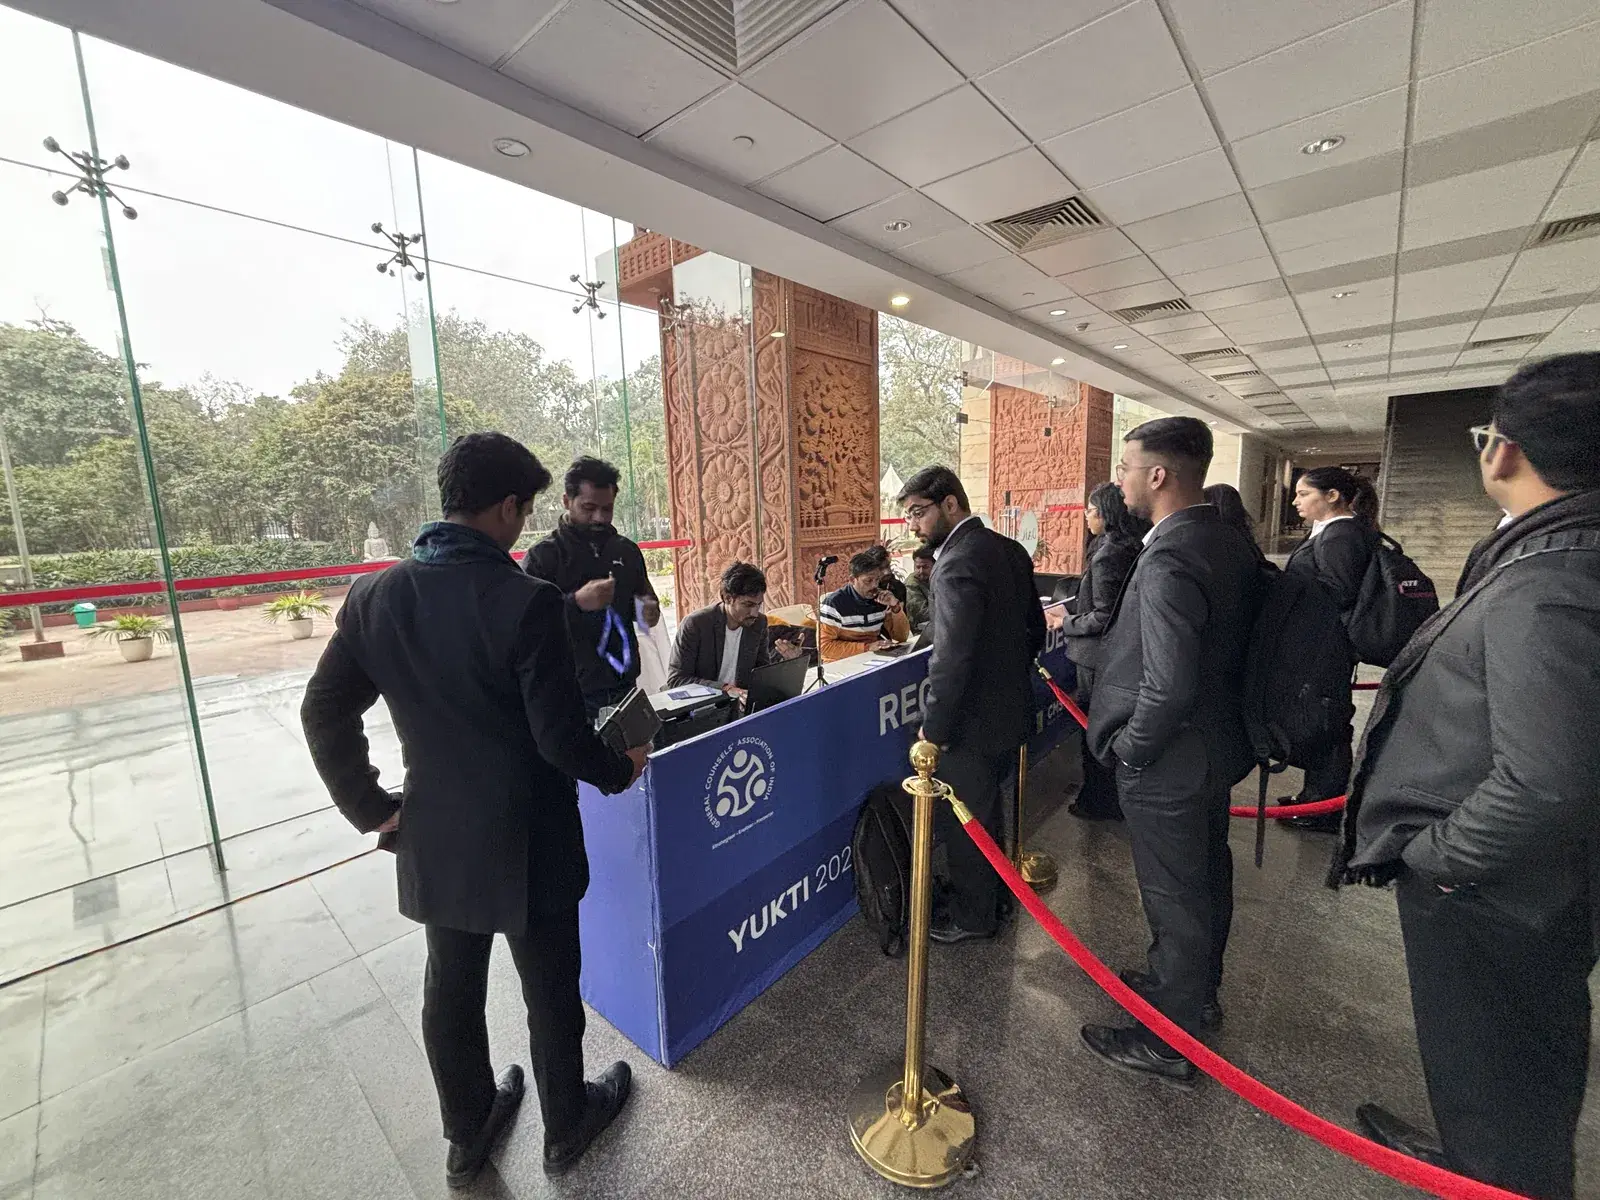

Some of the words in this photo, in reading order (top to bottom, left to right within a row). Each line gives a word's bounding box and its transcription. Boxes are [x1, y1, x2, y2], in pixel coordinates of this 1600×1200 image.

[1045, 628, 1068, 653] DE
[737, 736, 774, 760] ASSOCIATION
[705, 743, 734, 790] COUNSELS'
[769, 761, 776, 773] OF
[763, 776, 775, 801] INDIA
[704, 793, 721, 828] GENERAL
[728, 876, 809, 953] YUKTI
[815, 845, 852, 893] 202
